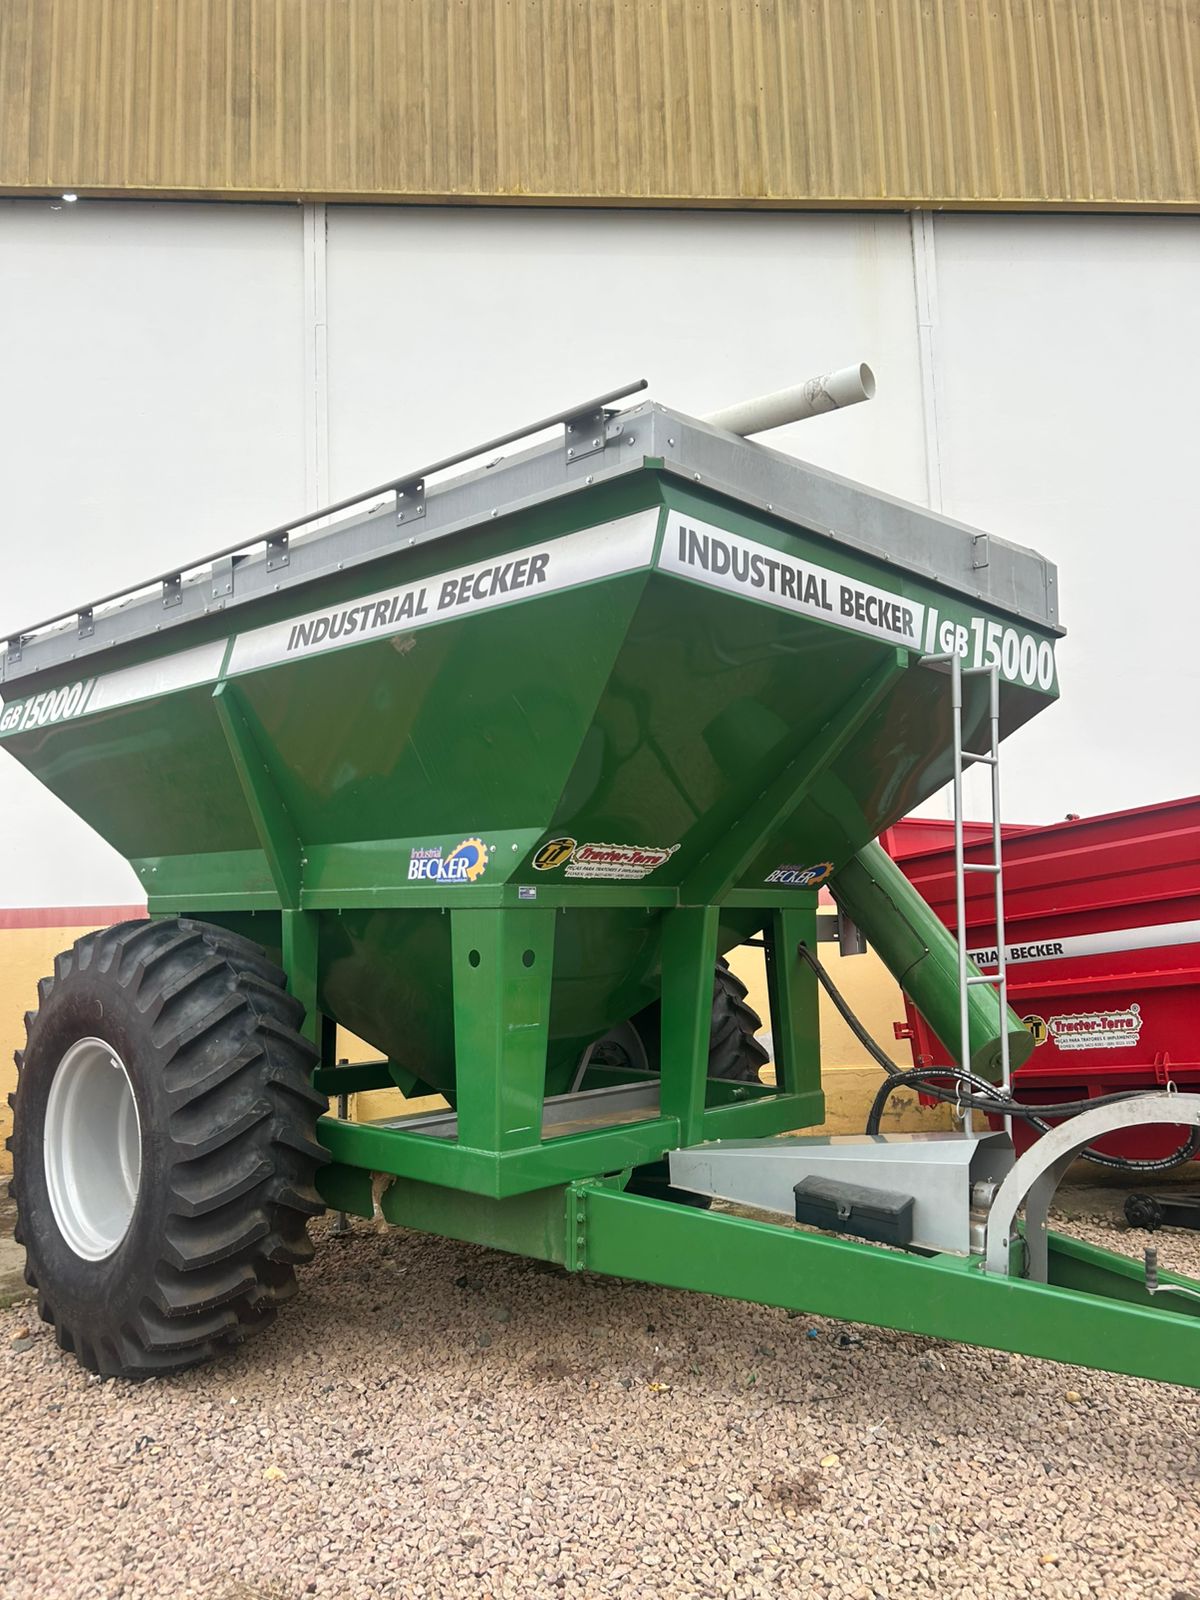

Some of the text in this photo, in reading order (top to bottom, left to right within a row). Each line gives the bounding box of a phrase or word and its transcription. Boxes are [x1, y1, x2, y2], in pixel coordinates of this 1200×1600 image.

[678, 526, 914, 637] INDUSTRIAL BECKER
[287, 552, 550, 650] INDUSTRIAL BECKER
[939, 617, 1054, 690] GB 15000
[1, 681, 83, 731] GB 15000
[411, 846, 442, 859] Industrial
[580, 847, 662, 864] Tractor-Terra
[408, 857, 469, 880] BECKER
[764, 869, 816, 883] BECKER
[969, 942, 1064, 964] TRIA BECKER
[1054, 1018, 1134, 1033] Tractor-Terra
